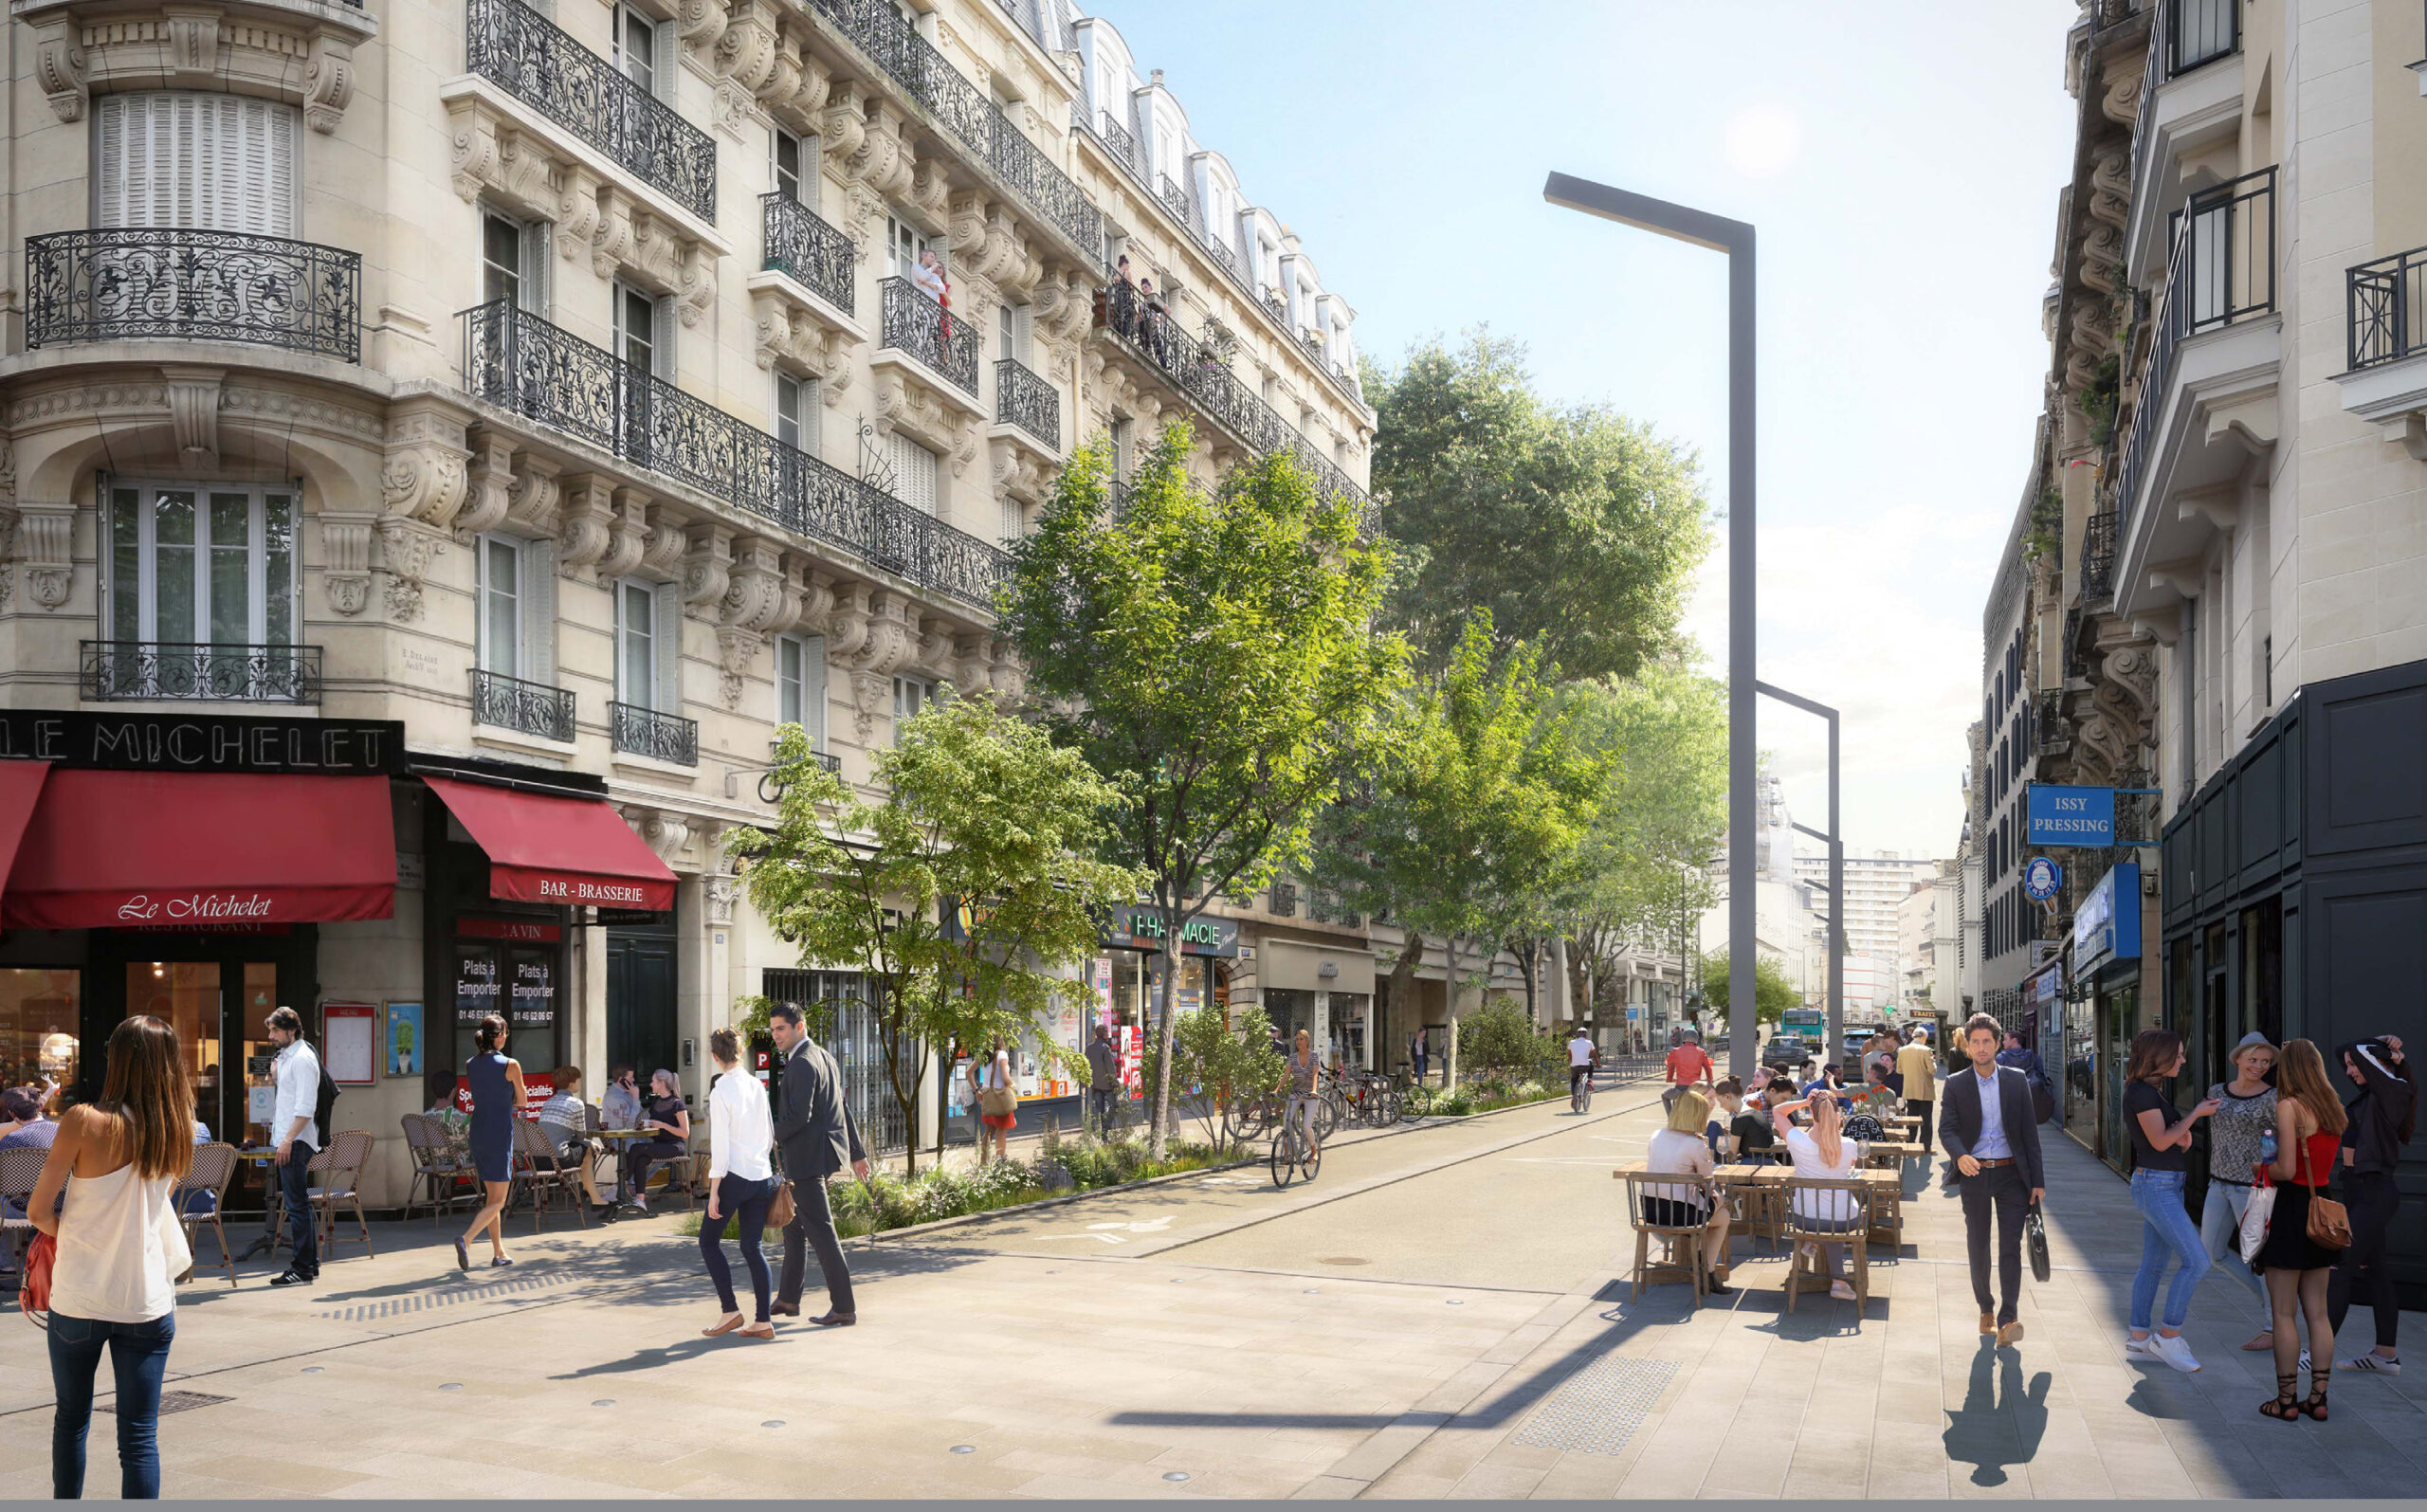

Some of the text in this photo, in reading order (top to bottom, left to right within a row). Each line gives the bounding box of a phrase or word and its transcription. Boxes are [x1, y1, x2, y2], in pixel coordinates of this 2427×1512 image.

[0, 719, 387, 768] LE MICHELET
[2055, 797, 2088, 811] ISSY
[2034, 818, 2109, 833] PRESSING
[540, 880, 568, 897] BAR
[578, 883, 644, 902] BRASSERIE
[118, 894, 273, 920] Le Michelet
[520, 925, 541, 938] VIN
[1137, 915, 1221, 945] PHAMACIE
[464, 959, 496, 975] Plats à
[518, 963, 549, 978] Plats à
[457, 980, 502, 998] Emporter
[512, 983, 555, 1000] Emporter
[758, 1053, 768, 1066] P
